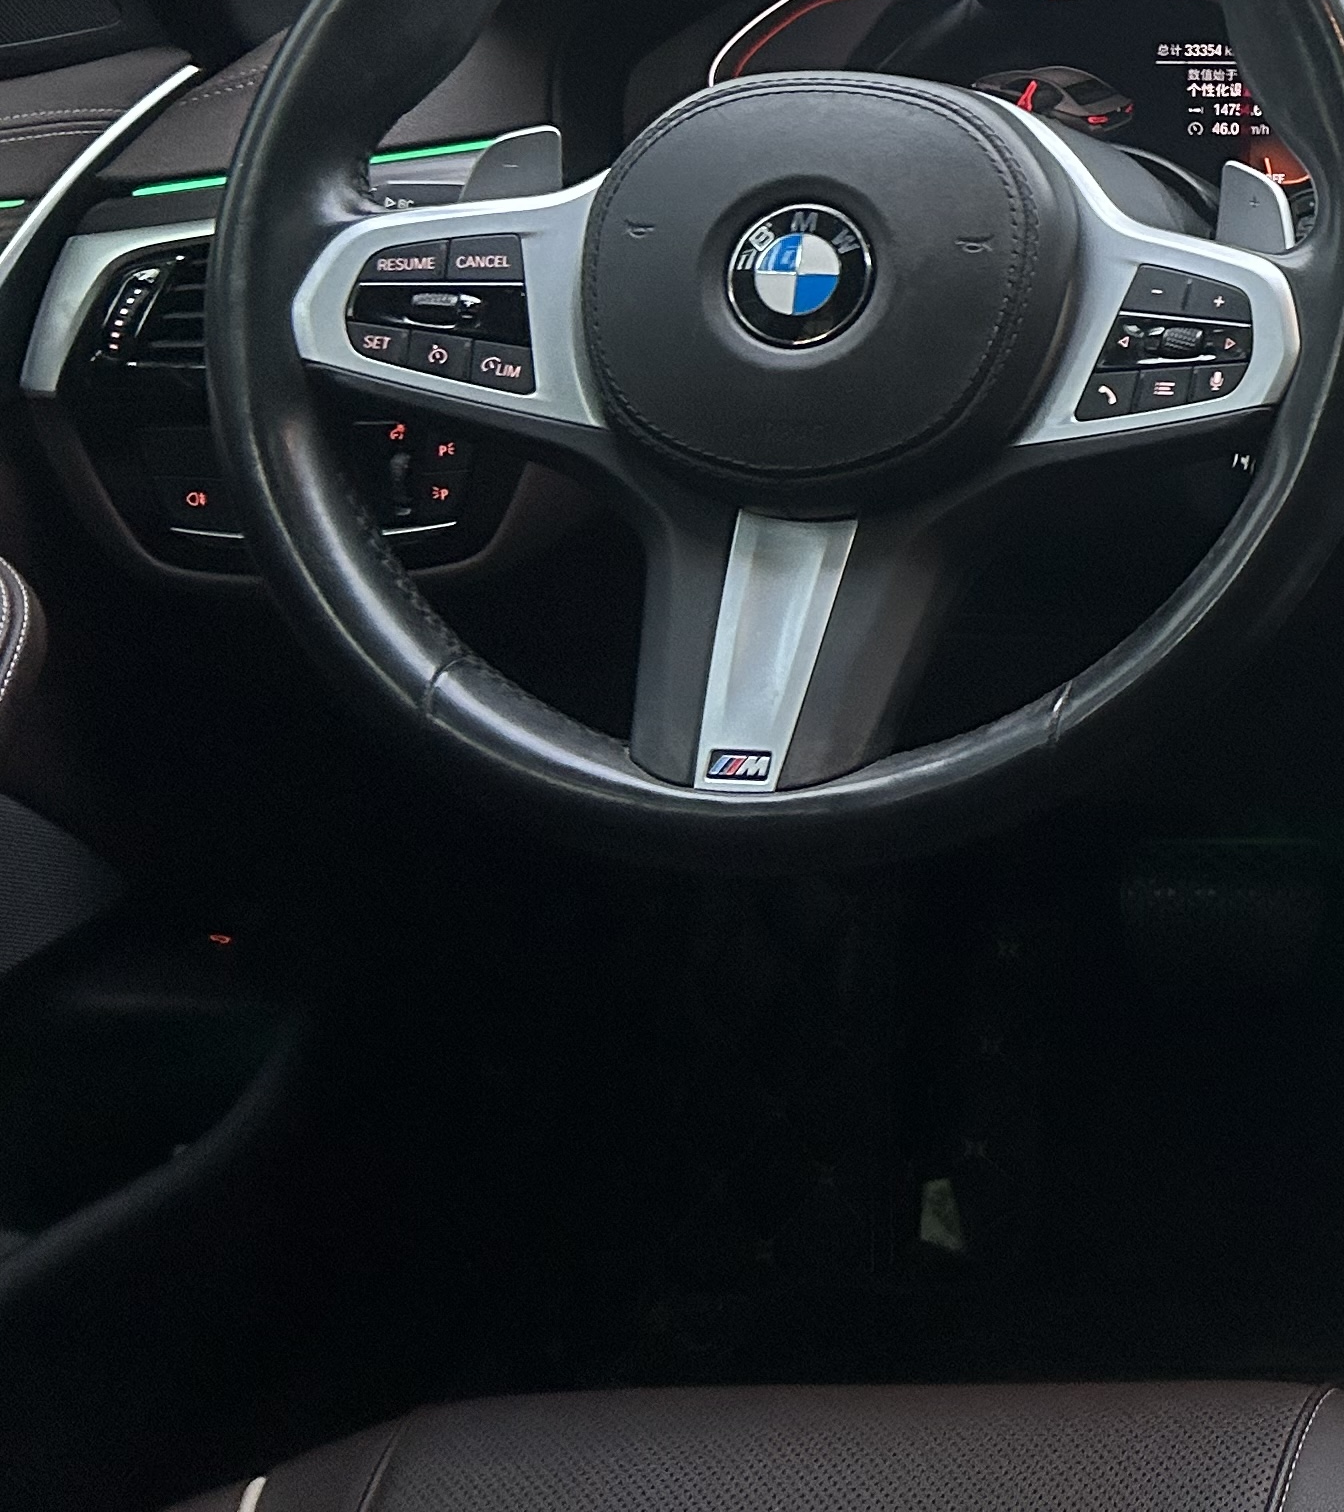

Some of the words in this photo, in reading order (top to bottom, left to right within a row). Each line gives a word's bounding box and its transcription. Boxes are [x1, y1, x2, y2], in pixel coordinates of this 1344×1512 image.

[1157, 44, 1182, 56] 总计
[1184, 44, 1222, 57] 33354
[1187, 69, 1238, 81] 数值始于
[1187, 82, 1251, 97] 个性化设
[1212, 122, 1239, 135] 46.0
[748, 211, 861, 255] BMW
[377, 256, 436, 271] RESUME
[455, 255, 511, 269] CANCEL
[363, 335, 392, 350] SET
[495, 363, 522, 378] LIM
